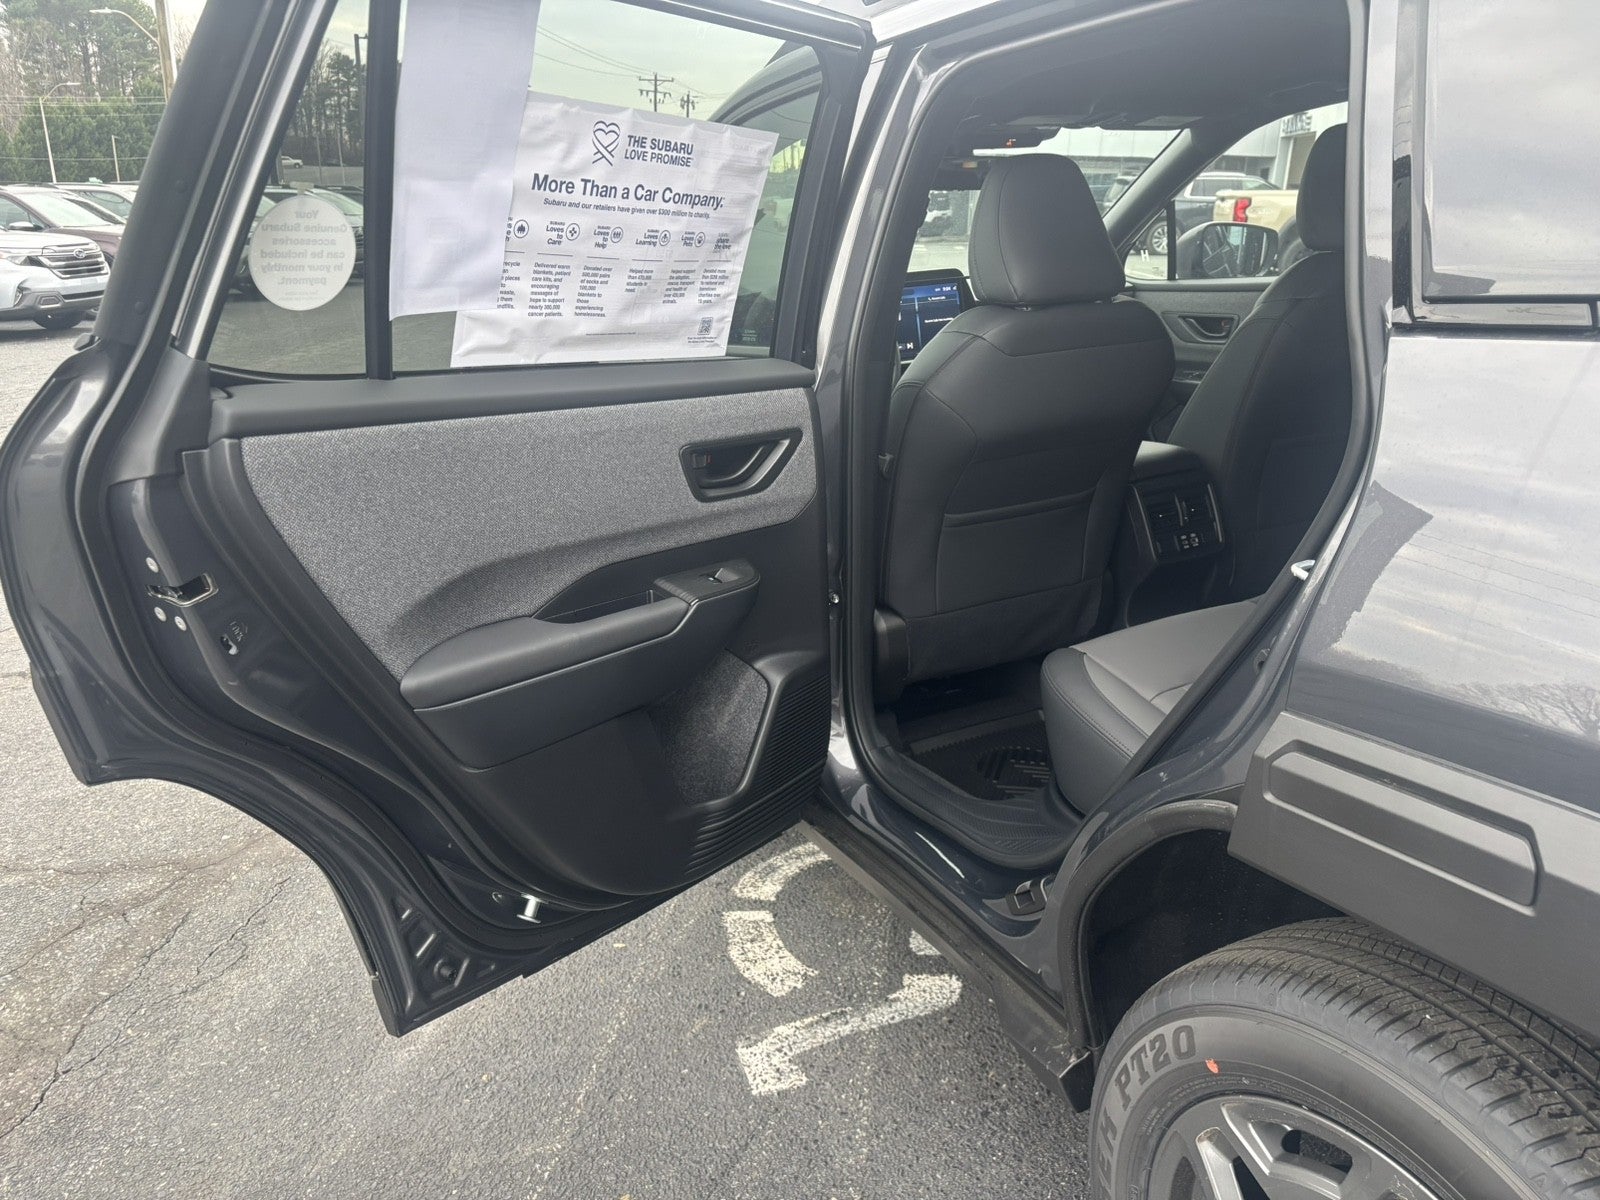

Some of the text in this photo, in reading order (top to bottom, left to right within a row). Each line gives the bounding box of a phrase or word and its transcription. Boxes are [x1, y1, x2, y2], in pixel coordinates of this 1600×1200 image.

[627, 135, 694, 155] THE SUBARU
[624, 149, 693, 168] LOVE PROMISE
[531, 173, 725, 212] More Than a Car Company.
[543, 198, 566, 208] Subaru
[568, 200, 580, 208] and
[593, 202, 616, 211] retailers
[617, 204, 630, 213] have
[631, 206, 645, 215] given
[672, 209, 687, 217] million
[694, 211, 711, 220] charity.
[546, 225, 564, 233] Loves
[594, 241, 607, 249] Help
[635, 238, 657, 247] Learning
[1114, 1025, 1196, 1112] PT20
